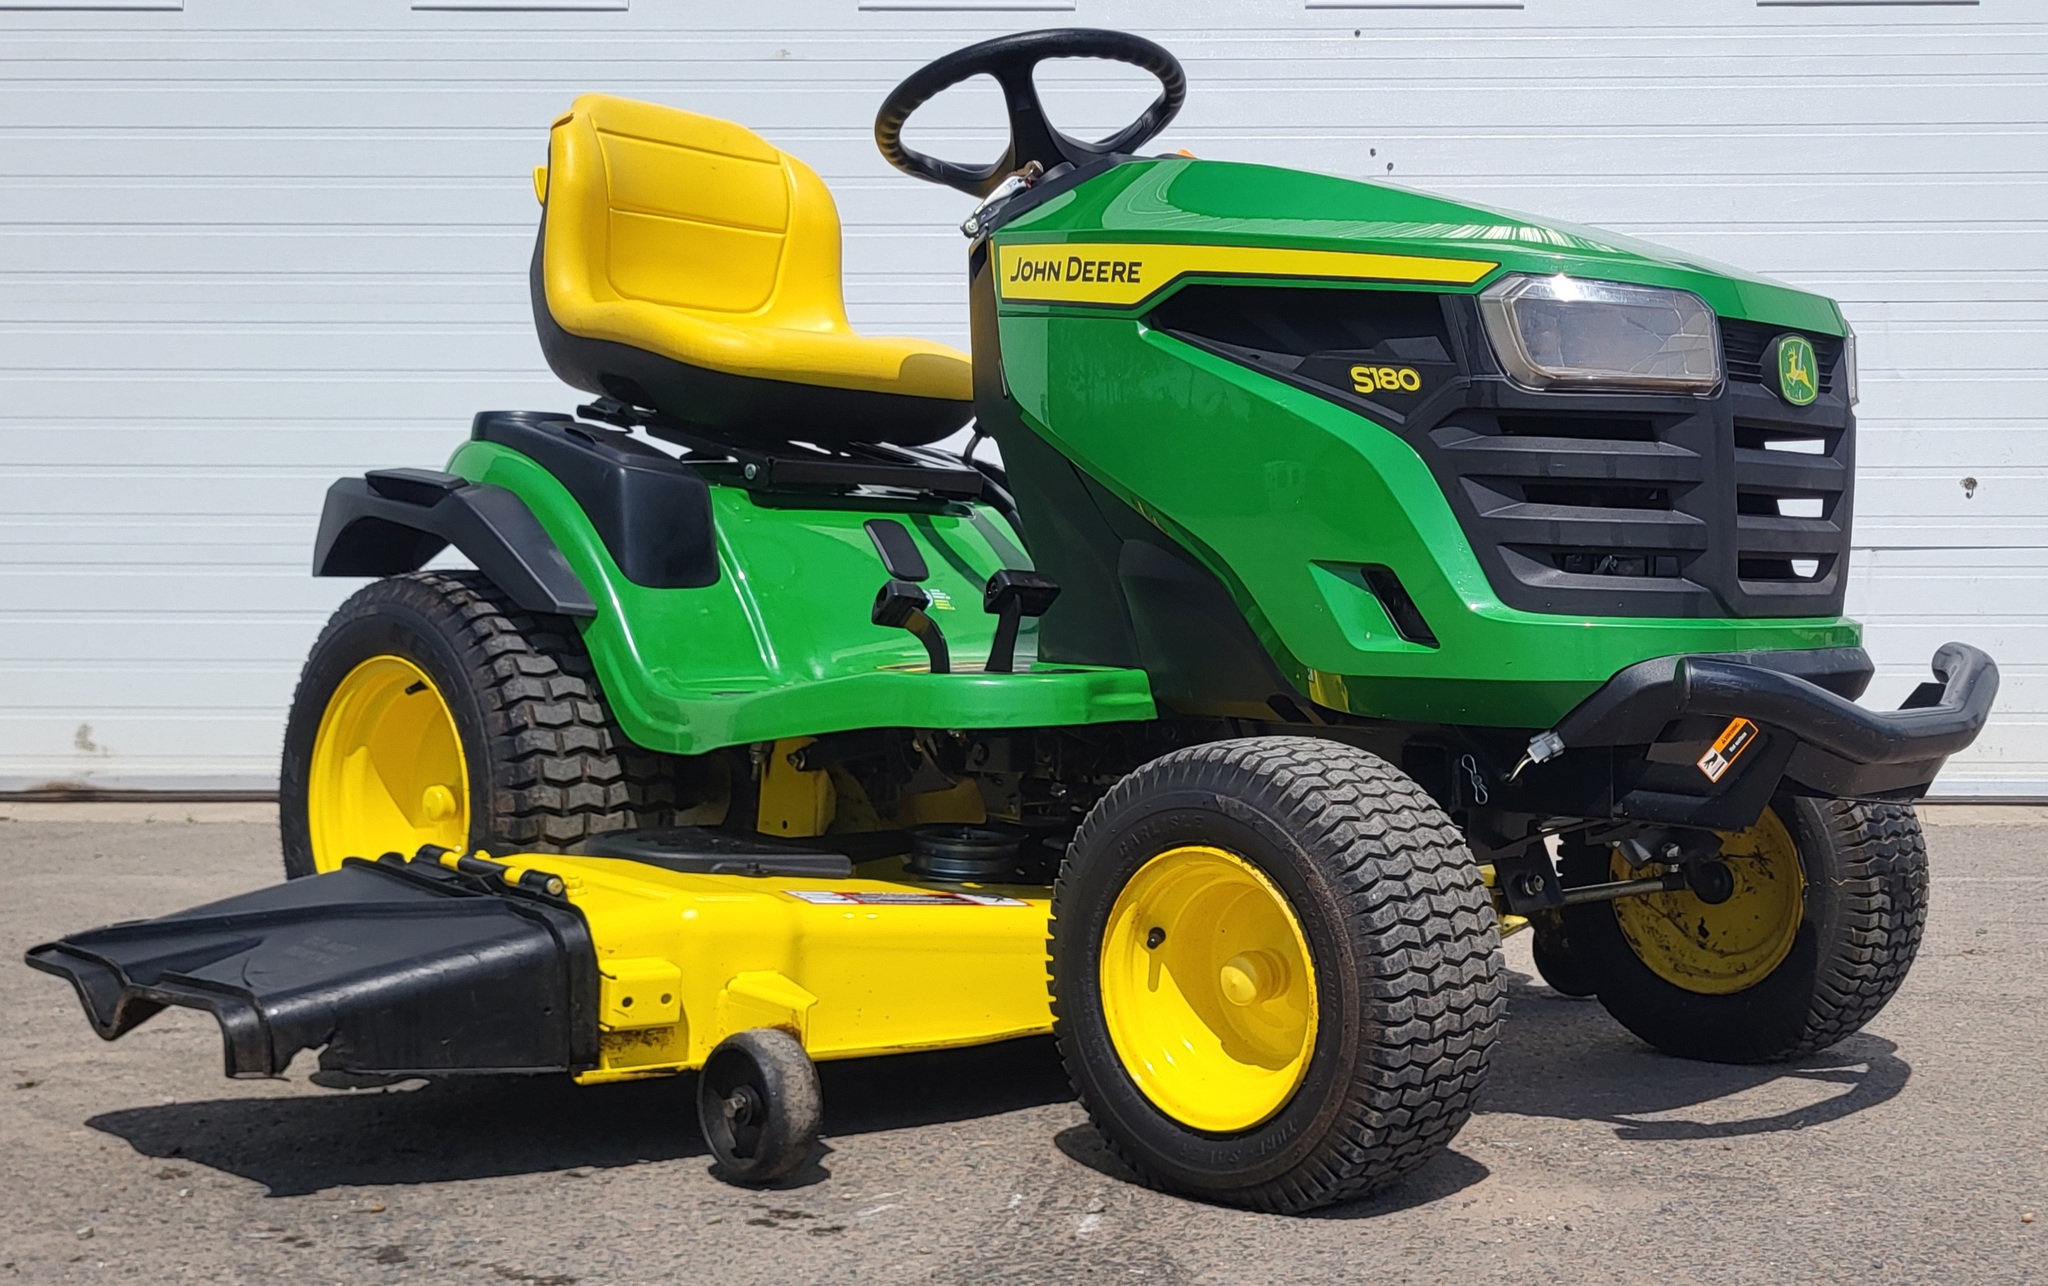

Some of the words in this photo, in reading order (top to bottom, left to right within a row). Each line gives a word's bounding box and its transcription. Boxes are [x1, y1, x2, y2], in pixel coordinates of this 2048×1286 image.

[1010, 256, 1062, 283] JOHN
[1065, 256, 1143, 284] DEERE
[1350, 366, 1421, 394] S180
